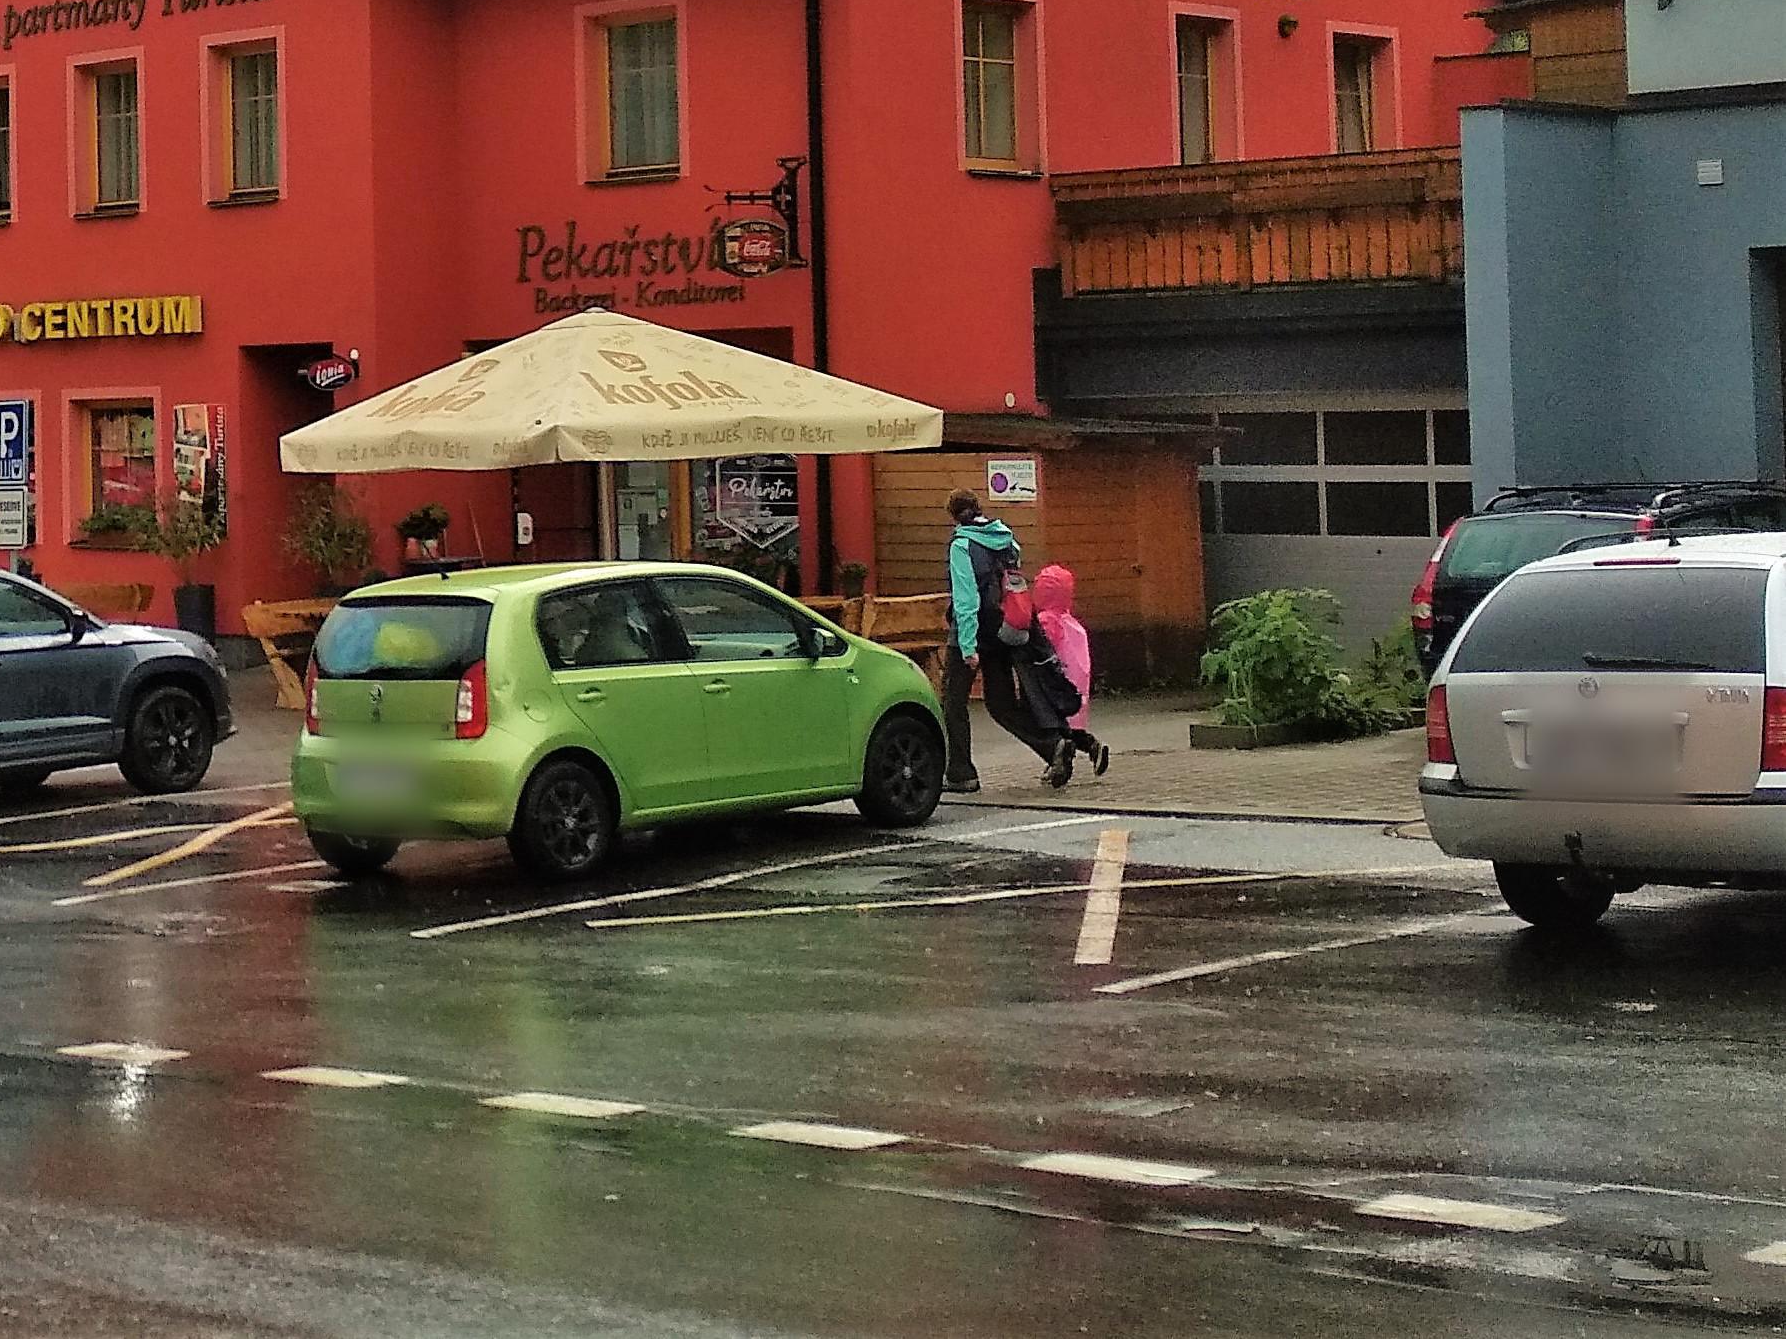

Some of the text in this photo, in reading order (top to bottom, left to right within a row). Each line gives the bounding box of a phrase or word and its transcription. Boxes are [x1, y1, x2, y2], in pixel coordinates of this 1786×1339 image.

[20, 295, 200, 343] CENTRUM
[579, 370, 748, 410] kofola
[0, 411, 20, 459] P
